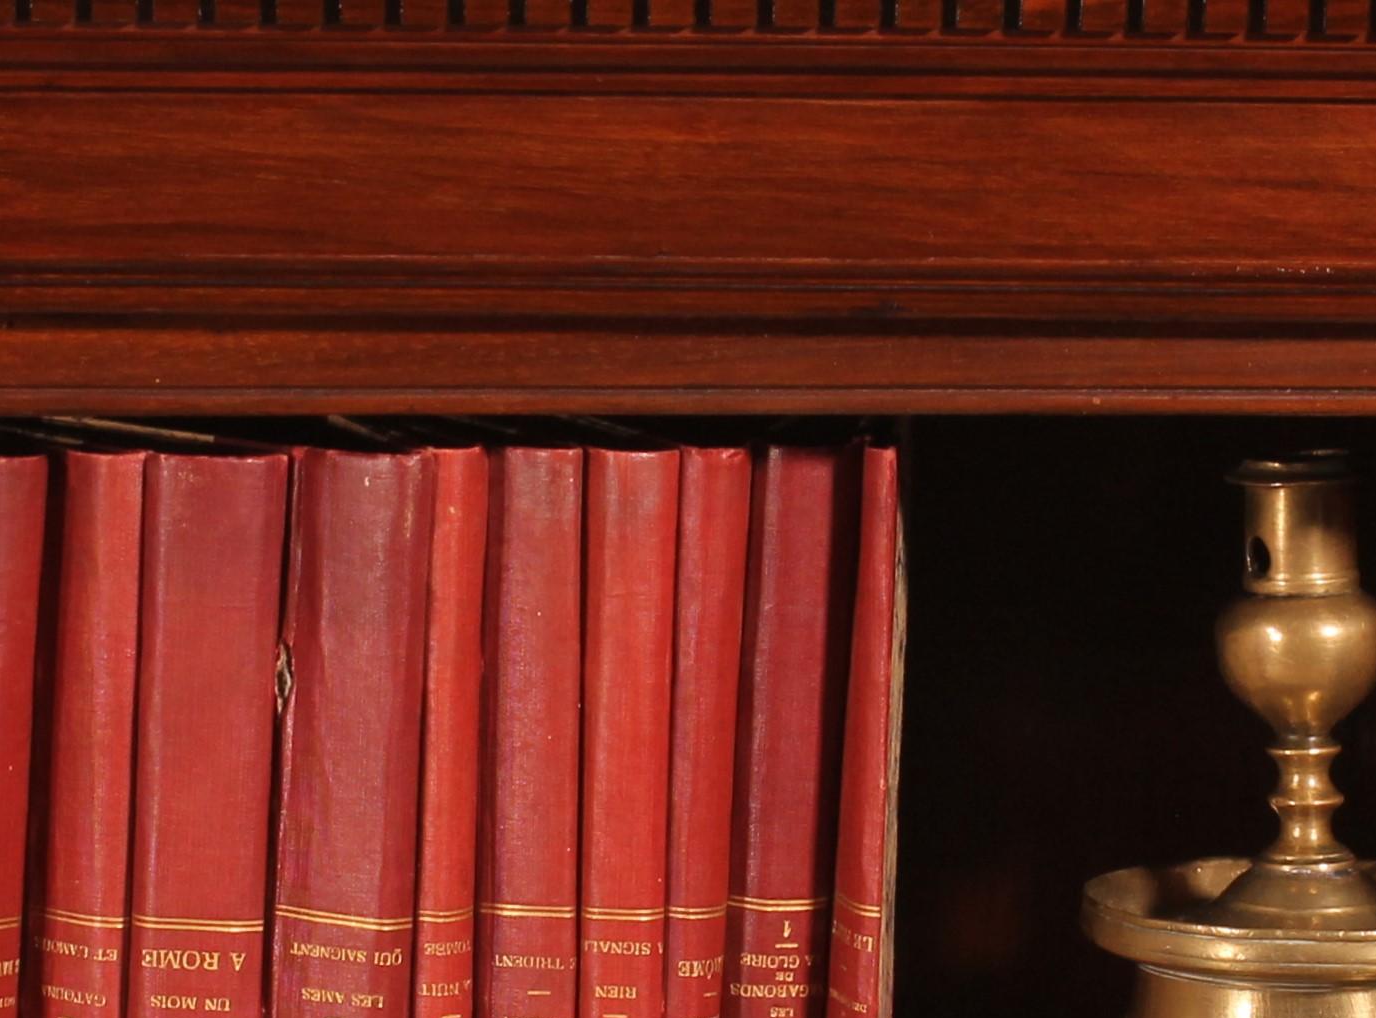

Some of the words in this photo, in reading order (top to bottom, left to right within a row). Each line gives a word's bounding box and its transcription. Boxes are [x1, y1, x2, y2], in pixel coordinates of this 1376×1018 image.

[783, 919, 793, 940] 1
[94, 948, 119, 961] ET
[141, 949, 220, 970] ROME
[289, 942, 367, 962] SAIGNENT
[373, 949, 403, 966] QUI
[228, 951, 247, 971] A
[492, 954, 565, 970] TRIDENT
[740, 952, 801, 969] GLOIRE
[774, 970, 795, 983] DE
[301, 988, 345, 1004] AMES
[418, 982, 461, 997] NUIT
[594, 986, 638, 999] RIEN
[149, 995, 198, 1011] MOIS
[204, 997, 231, 1011] UN
[350, 994, 384, 1008] LES
